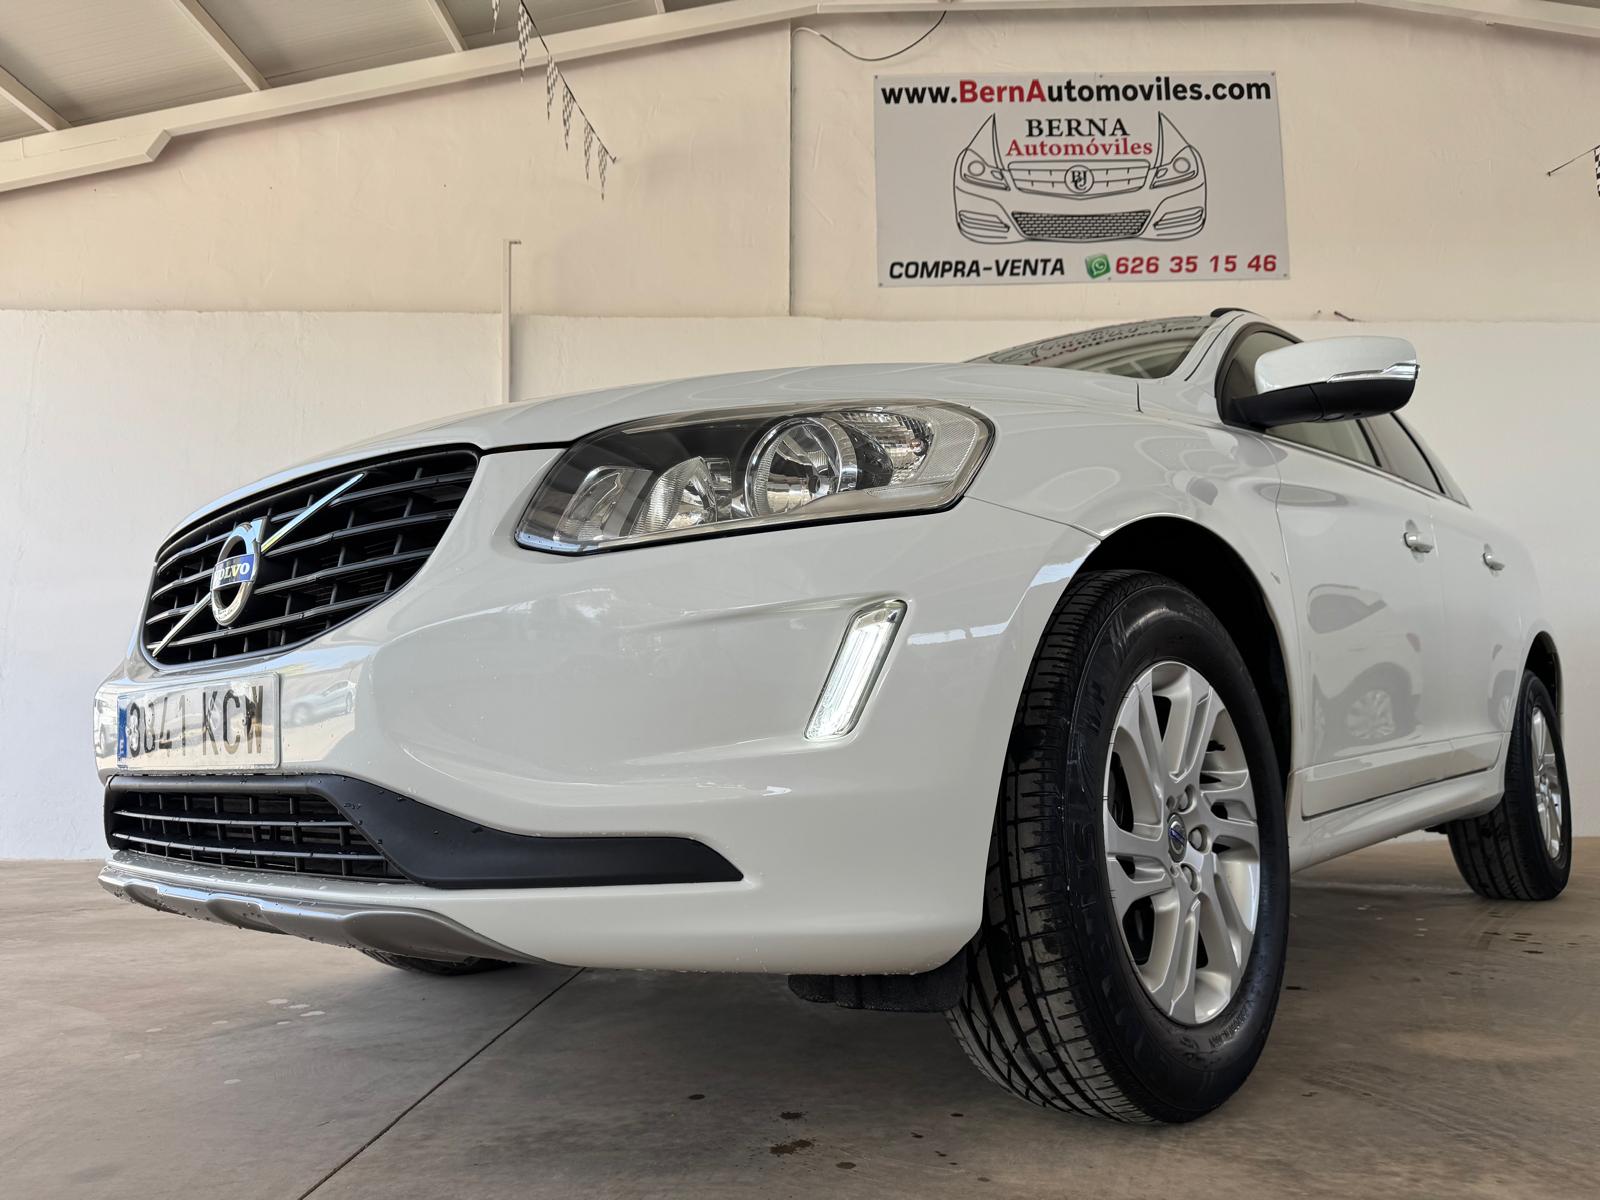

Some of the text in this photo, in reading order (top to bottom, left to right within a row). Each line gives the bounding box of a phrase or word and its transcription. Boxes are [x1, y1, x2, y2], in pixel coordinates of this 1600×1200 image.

[881, 77, 1271, 104] www.BernAutomoviles.com
[1025, 117, 1130, 138] BERNA
[1005, 137, 1153, 157] Automóviles
[889, 258, 1065, 279] COMPRA-VENTA
[1115, 254, 1278, 275] 626 35 15 46
[214, 562, 250, 580] OLVO
[202, 685, 263, 756] KCW
